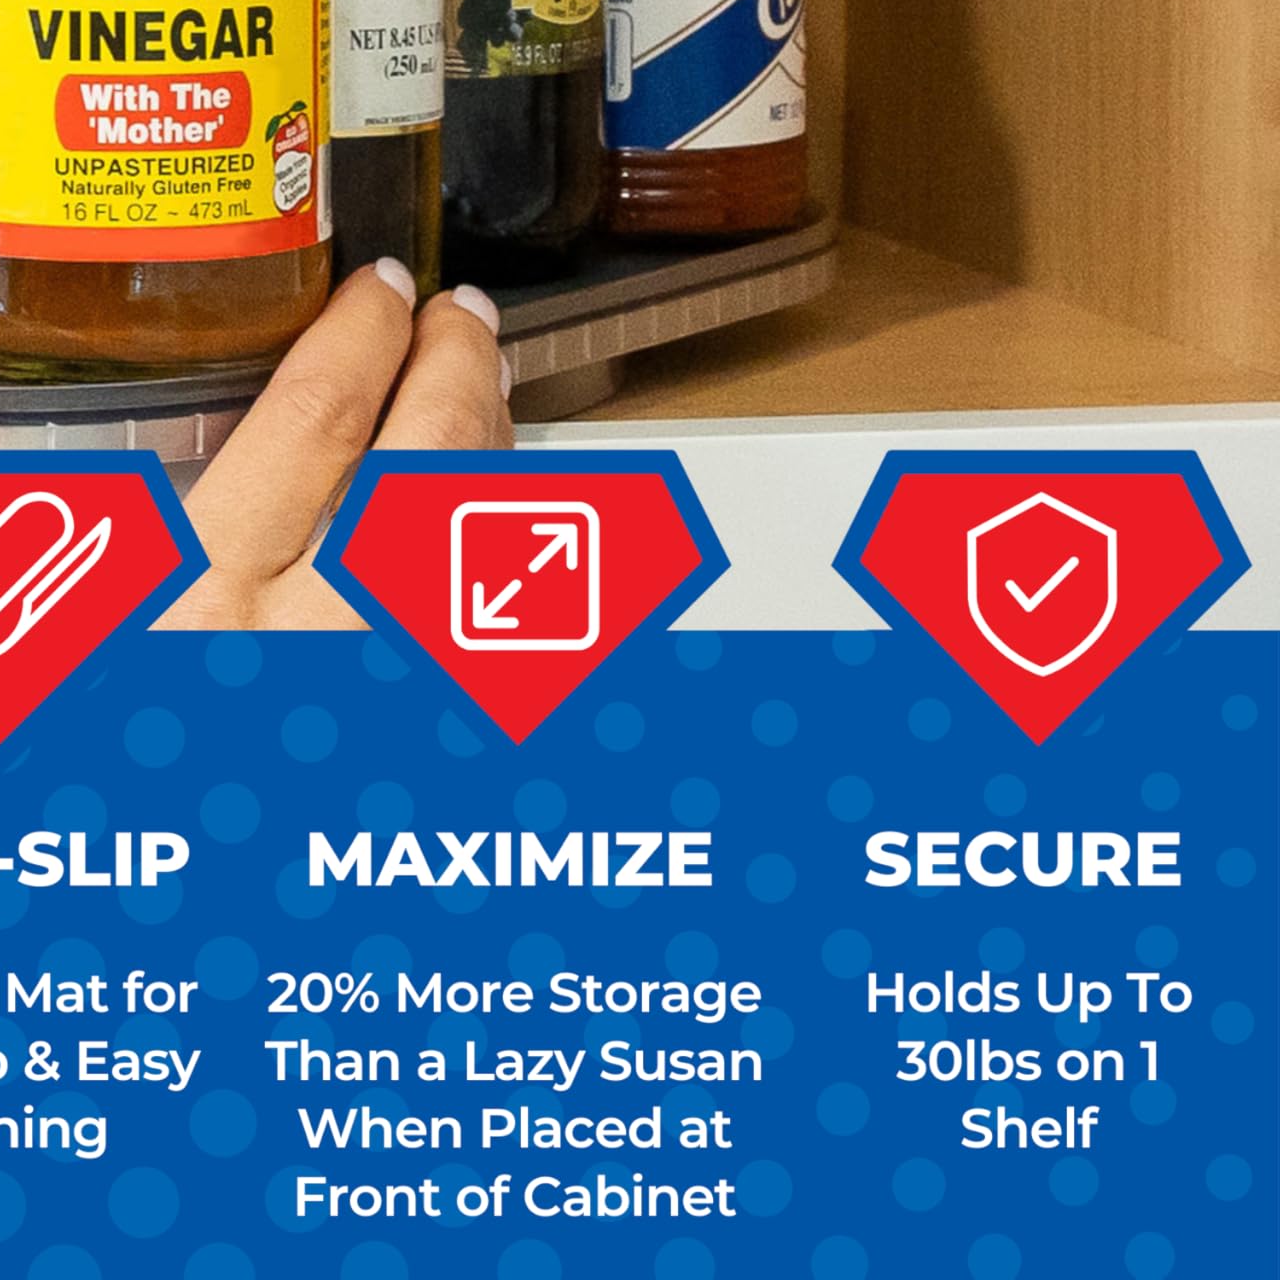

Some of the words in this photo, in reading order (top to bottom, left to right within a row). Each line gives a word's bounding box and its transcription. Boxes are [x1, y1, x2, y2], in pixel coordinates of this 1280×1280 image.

[29, 6, 274, 62] VINEGAR
[350, 28, 386, 50] NET
[384, 54, 418, 80] (250
[80, 83, 160, 112] With
[170, 83, 231, 110] The
[89, 115, 225, 145] 'Mother'
[55, 154, 255, 177] UNPASTEURIZED
[61, 179, 145, 199] Naturally
[152, 177, 210, 197] Gluten
[216, 176, 252, 193] Free
[62, 203, 87, 221] 16
[94, 204, 119, 222] FL
[129, 204, 157, 222] OZ
[188, 203, 222, 220] 473
[228, 202, 254, 218] mL
